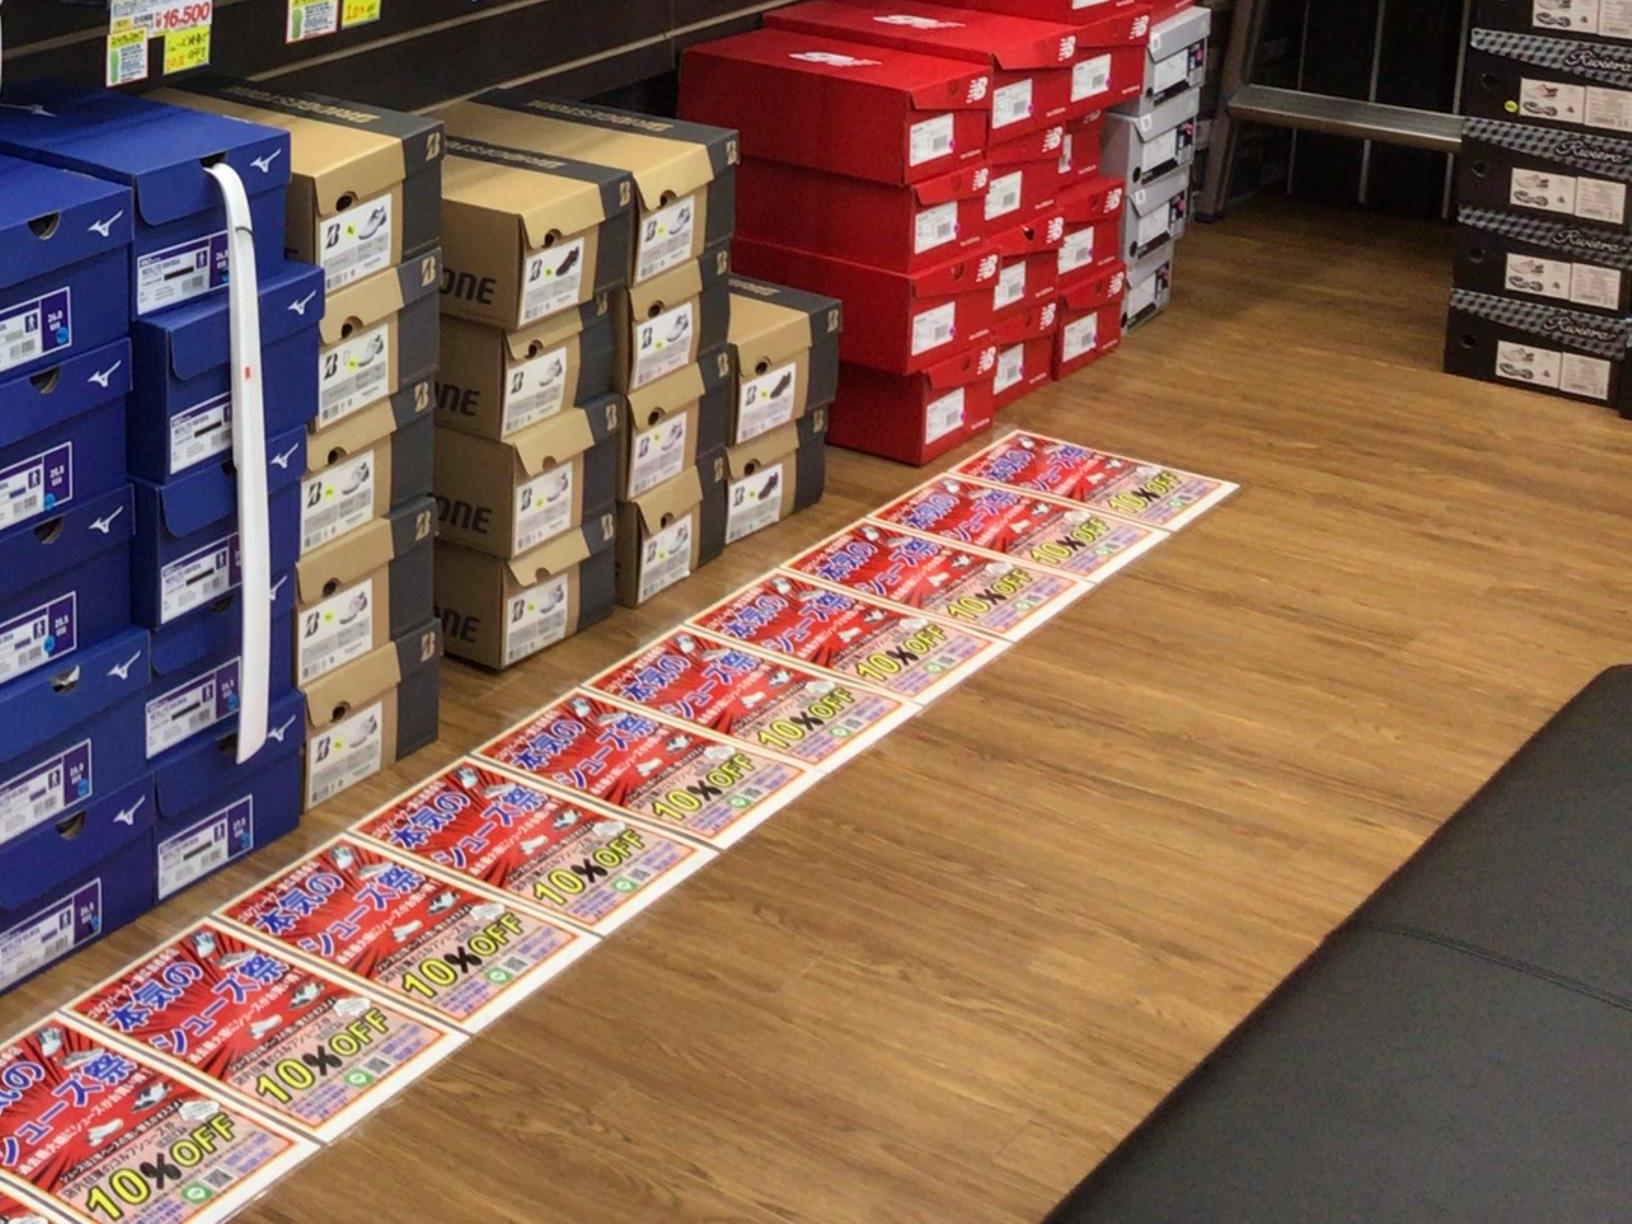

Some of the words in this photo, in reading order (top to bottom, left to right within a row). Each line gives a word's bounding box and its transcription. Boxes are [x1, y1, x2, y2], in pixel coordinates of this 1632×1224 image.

[155, 2, 211, 30] ¥16,500
[510, 717, 585, 771] 本気の
[389, 789, 470, 851] 本気の
[433, 783, 547, 870] シューズ祭
[650, 752, 756, 823] 10%OFF
[256, 871, 344, 936] 本気の
[531, 828, 647, 907] 10%OFF
[298, 864, 424, 959] シューズ祭
[106, 960, 202, 1032] 本気の
[400, 912, 523, 1001] 10%OFF
[149, 951, 289, 1053] シューズ祭
[255, 1006, 389, 1104] 10%OFF
[85, 1111, 234, 1223] 10%OFF
